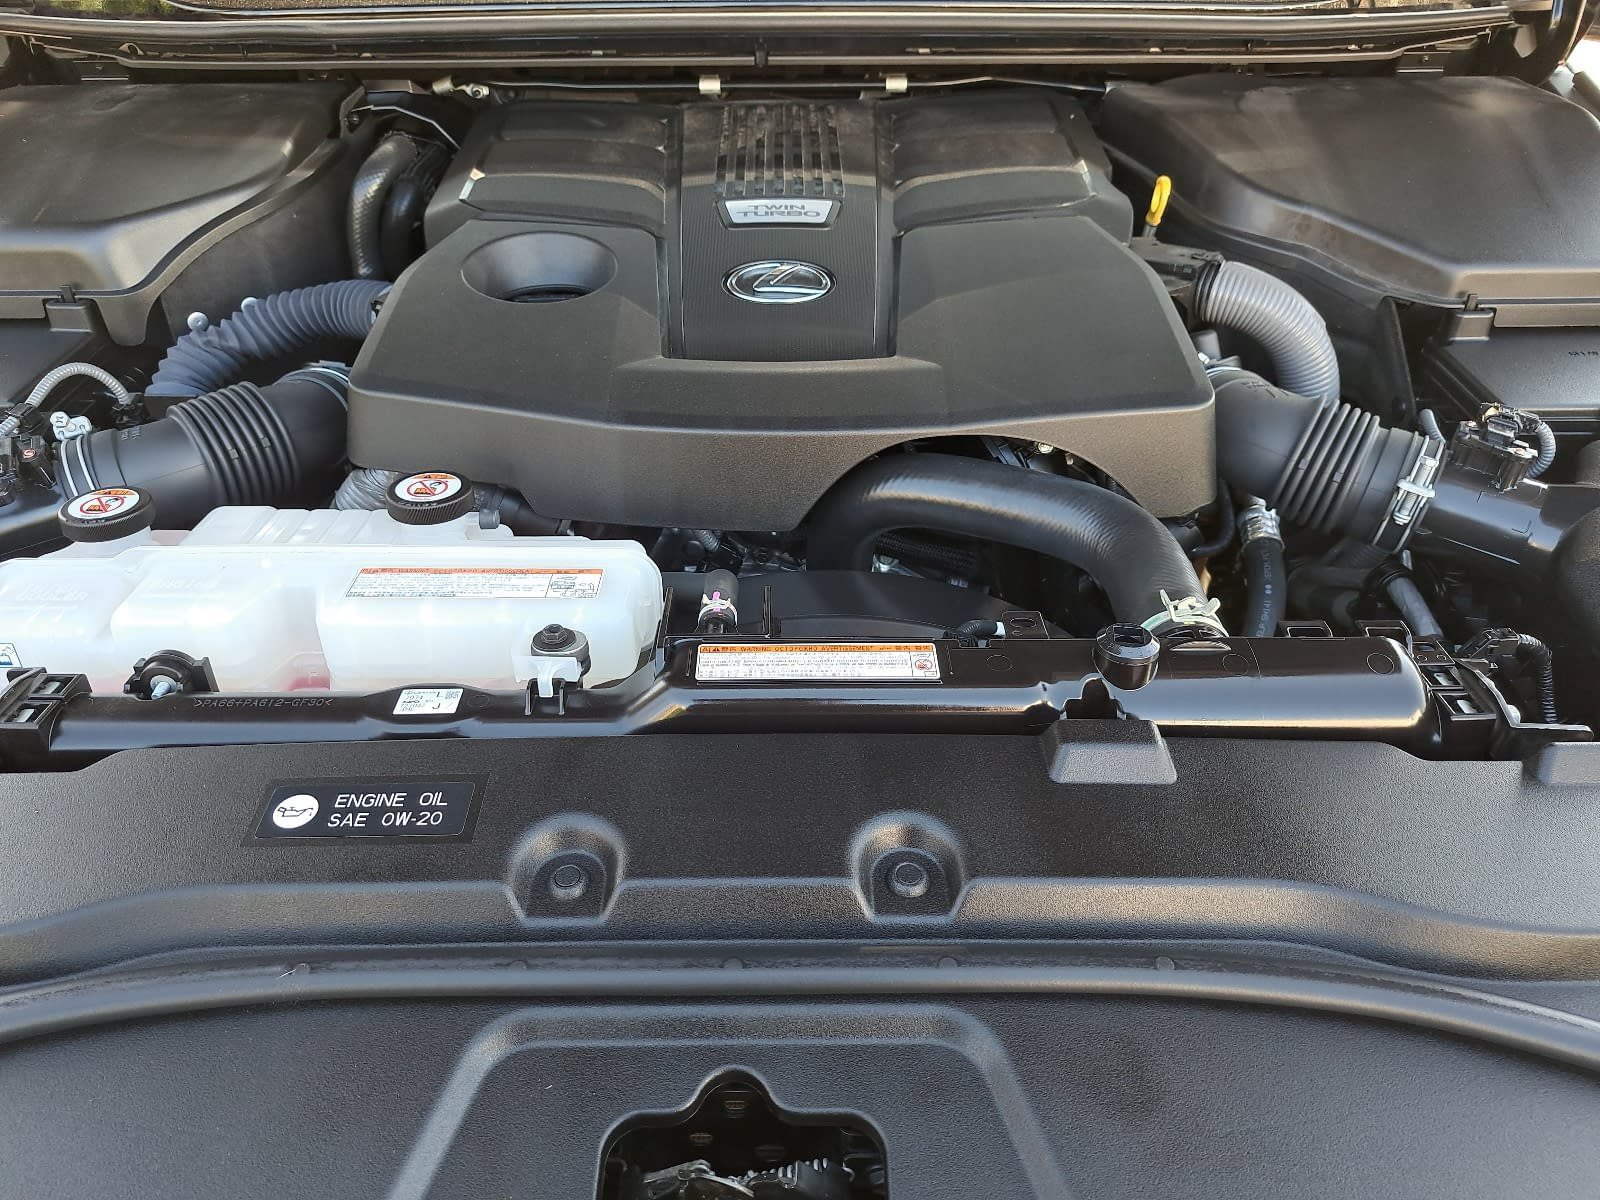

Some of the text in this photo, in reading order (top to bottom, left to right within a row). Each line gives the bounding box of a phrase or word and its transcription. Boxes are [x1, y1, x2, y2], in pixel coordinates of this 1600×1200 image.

[736, 210, 821, 218] TURBO
[334, 791, 448, 808] ENGINE OIL
[327, 811, 443, 827] SAE 0W-20
